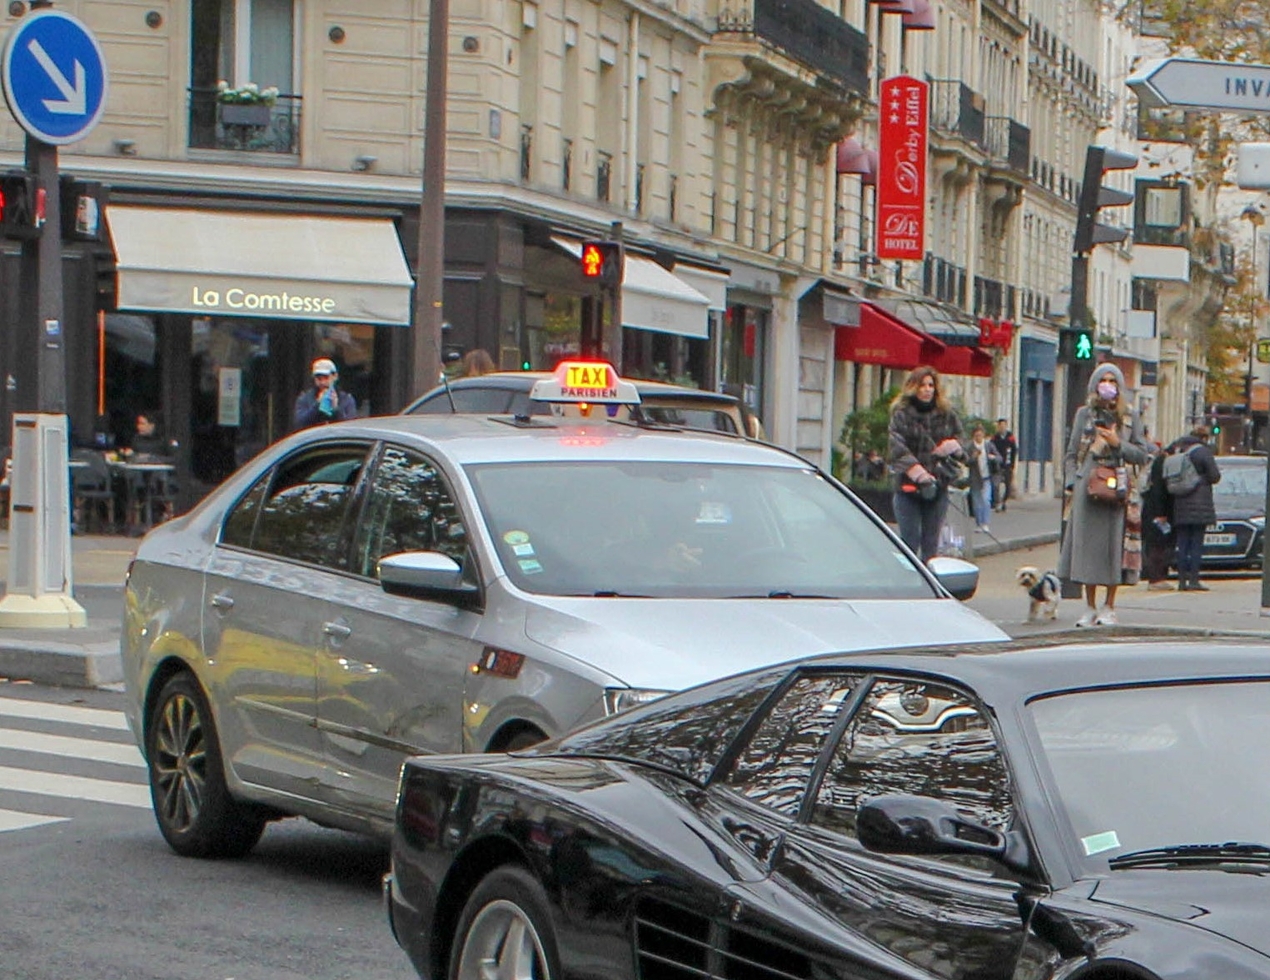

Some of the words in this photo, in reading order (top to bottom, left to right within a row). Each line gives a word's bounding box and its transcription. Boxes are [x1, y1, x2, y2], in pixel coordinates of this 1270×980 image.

[905, 86, 920, 127] Eiffel
[895, 128, 921, 196] Derby
[884, 238, 919, 250] HOTEL
[192, 286, 220, 307] La
[226, 288, 336, 313] Comtesse
[569, 367, 609, 386] TAXI
[561, 387, 617, 398] PARISIEN
